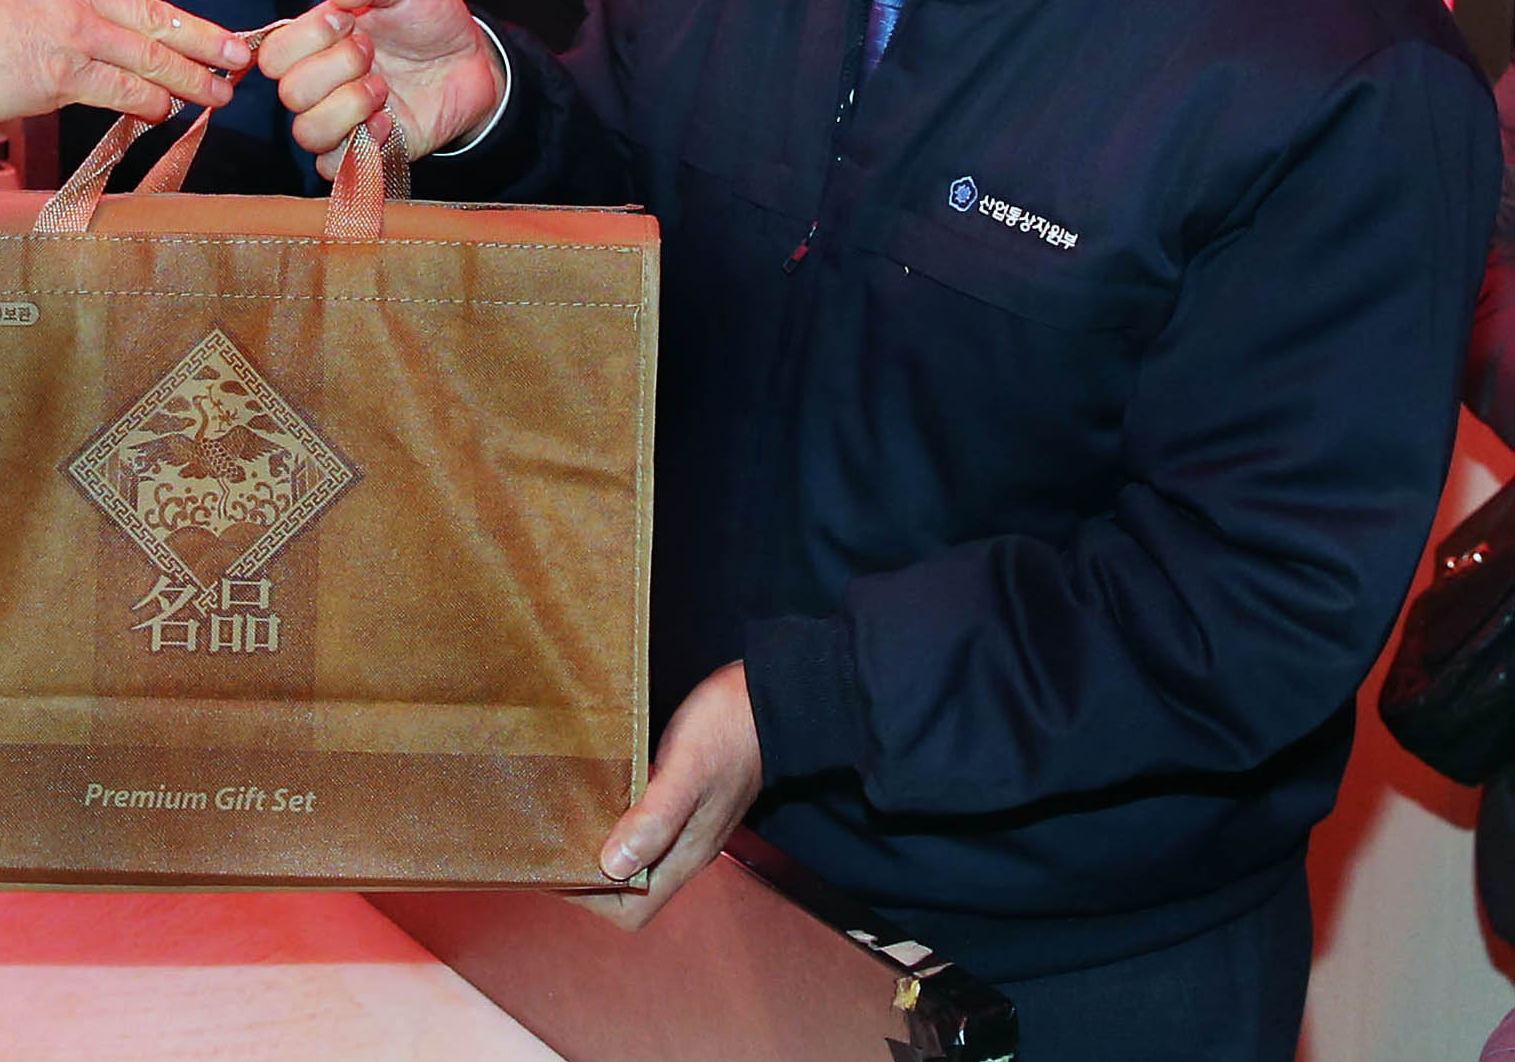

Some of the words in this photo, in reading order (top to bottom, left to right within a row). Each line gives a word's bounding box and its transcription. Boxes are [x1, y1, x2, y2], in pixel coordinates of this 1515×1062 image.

[978, 194, 1079, 250] 산업통상자원부
[131, 575, 281, 652] 名品
[84, 784, 208, 810] Premium
[214, 787, 266, 812] Gift
[271, 788, 317, 813] Set
